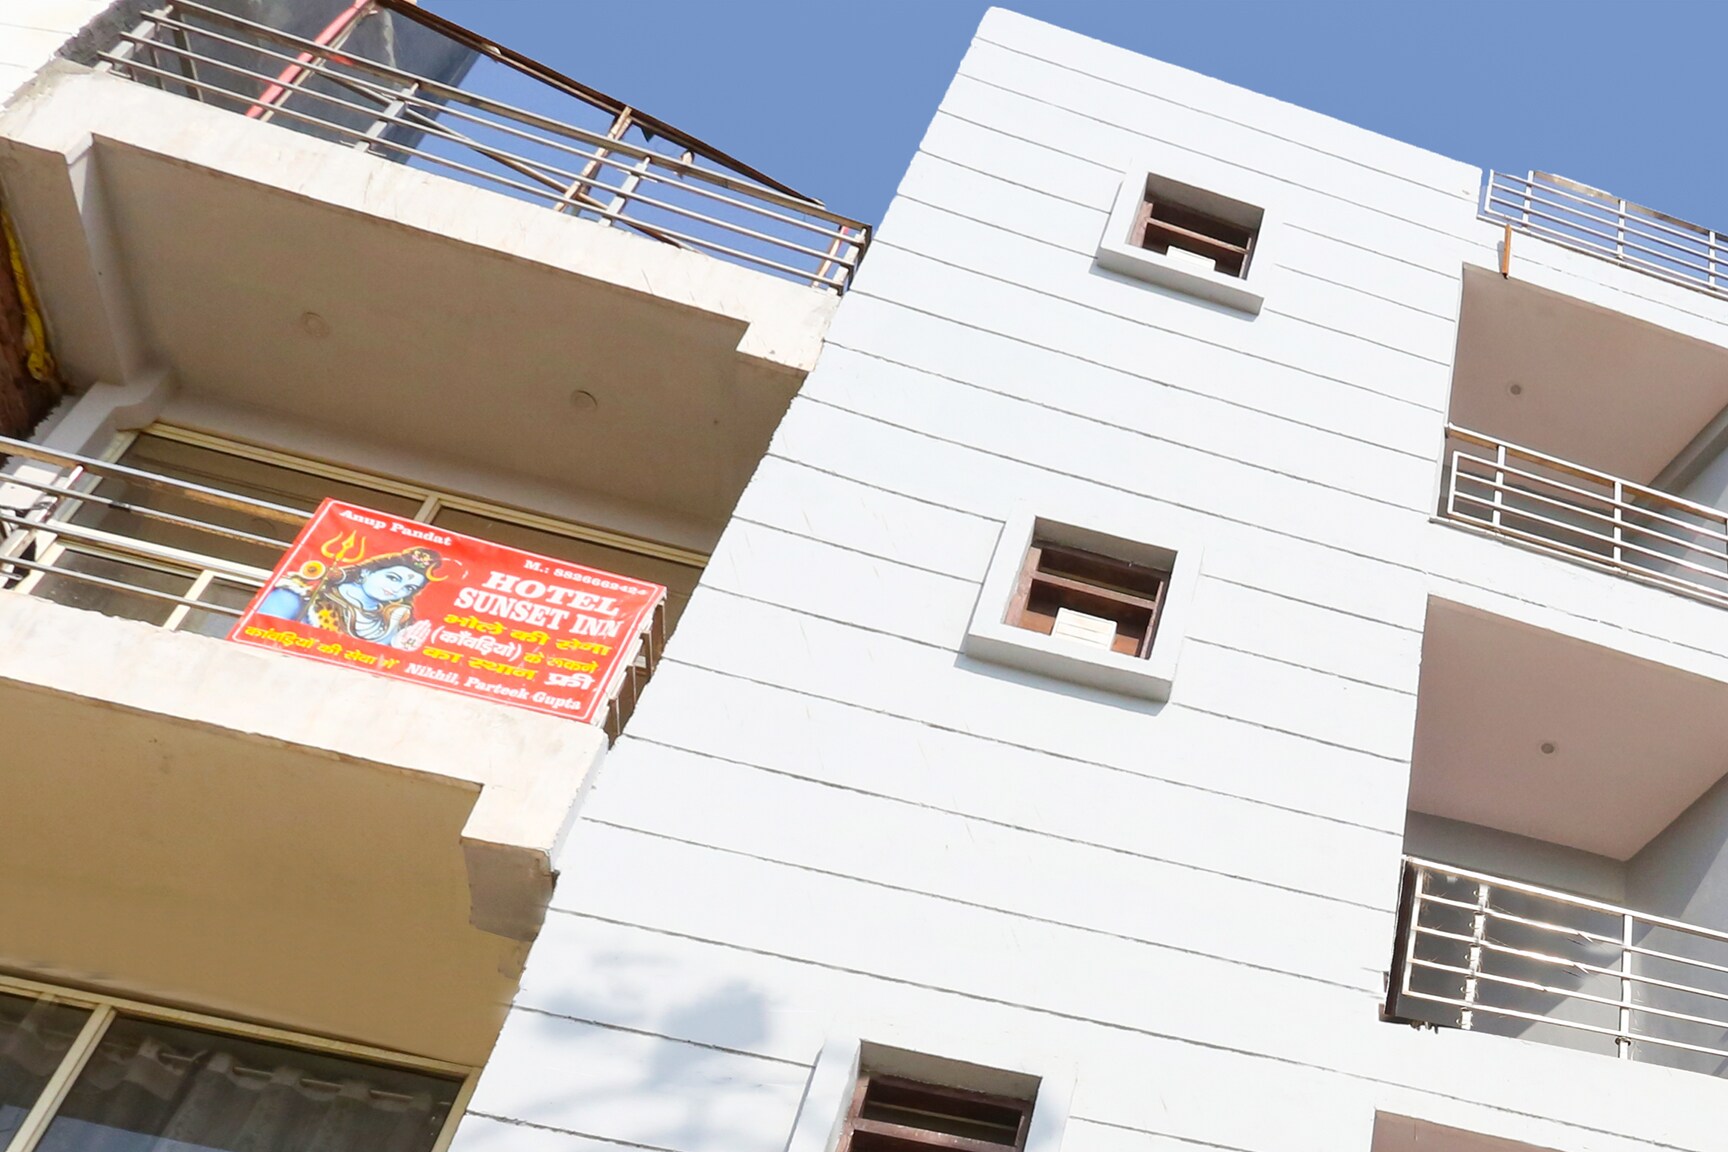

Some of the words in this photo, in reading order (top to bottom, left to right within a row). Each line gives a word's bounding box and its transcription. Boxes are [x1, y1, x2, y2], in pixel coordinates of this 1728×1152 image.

[339, 509, 387, 530] Anup
[390, 521, 453, 546] Pandat
[453, 587, 570, 631] SUNSET
[568, 613, 625, 638] INN
[481, 571, 620, 617] HOTEL
[422, 645, 465, 664] का
[510, 628, 551, 646] की
[404, 662, 460, 686] Nikhil,
[532, 691, 582, 711] Gupta
